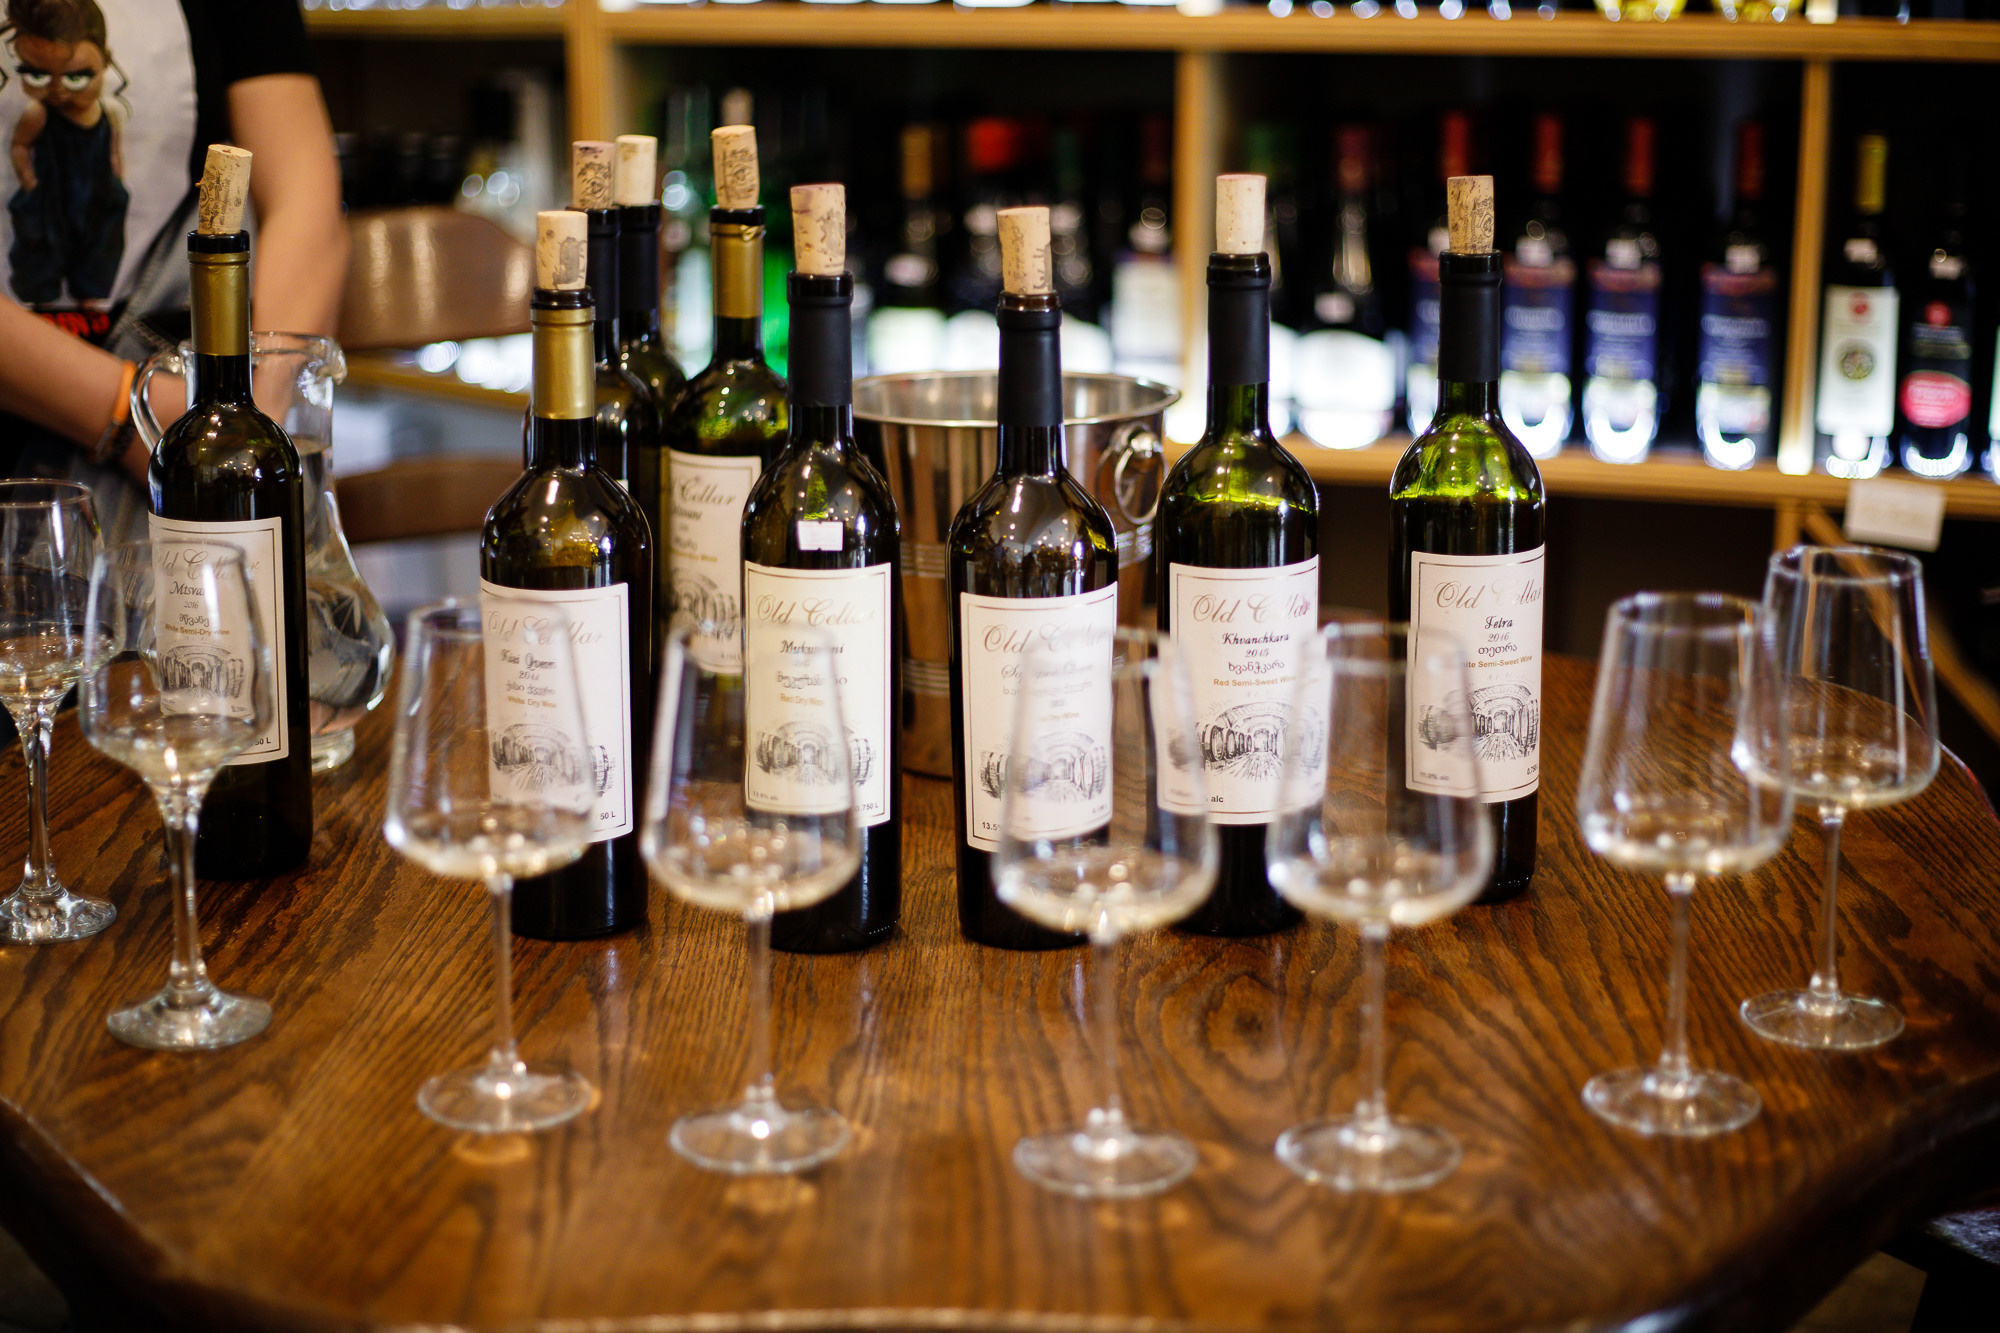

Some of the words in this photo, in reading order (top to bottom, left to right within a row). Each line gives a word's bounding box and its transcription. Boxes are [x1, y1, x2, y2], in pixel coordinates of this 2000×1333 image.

[1434, 580, 1487, 609] Old
[756, 594, 797, 626] Old
[1191, 593, 1241, 624] Old
[982, 623, 1033, 654] Old
[1221, 631, 1290, 646] Khvanchkara
[1488, 631, 1511, 643] 2016
[1244, 647, 1270, 658] 2015
[1478, 657, 1520, 669] Semi-Sweet
[1213, 678, 1230, 687] Red
[1231, 677, 1279, 688] Semi-Sweet
[1210, 795, 1225, 803] alc
